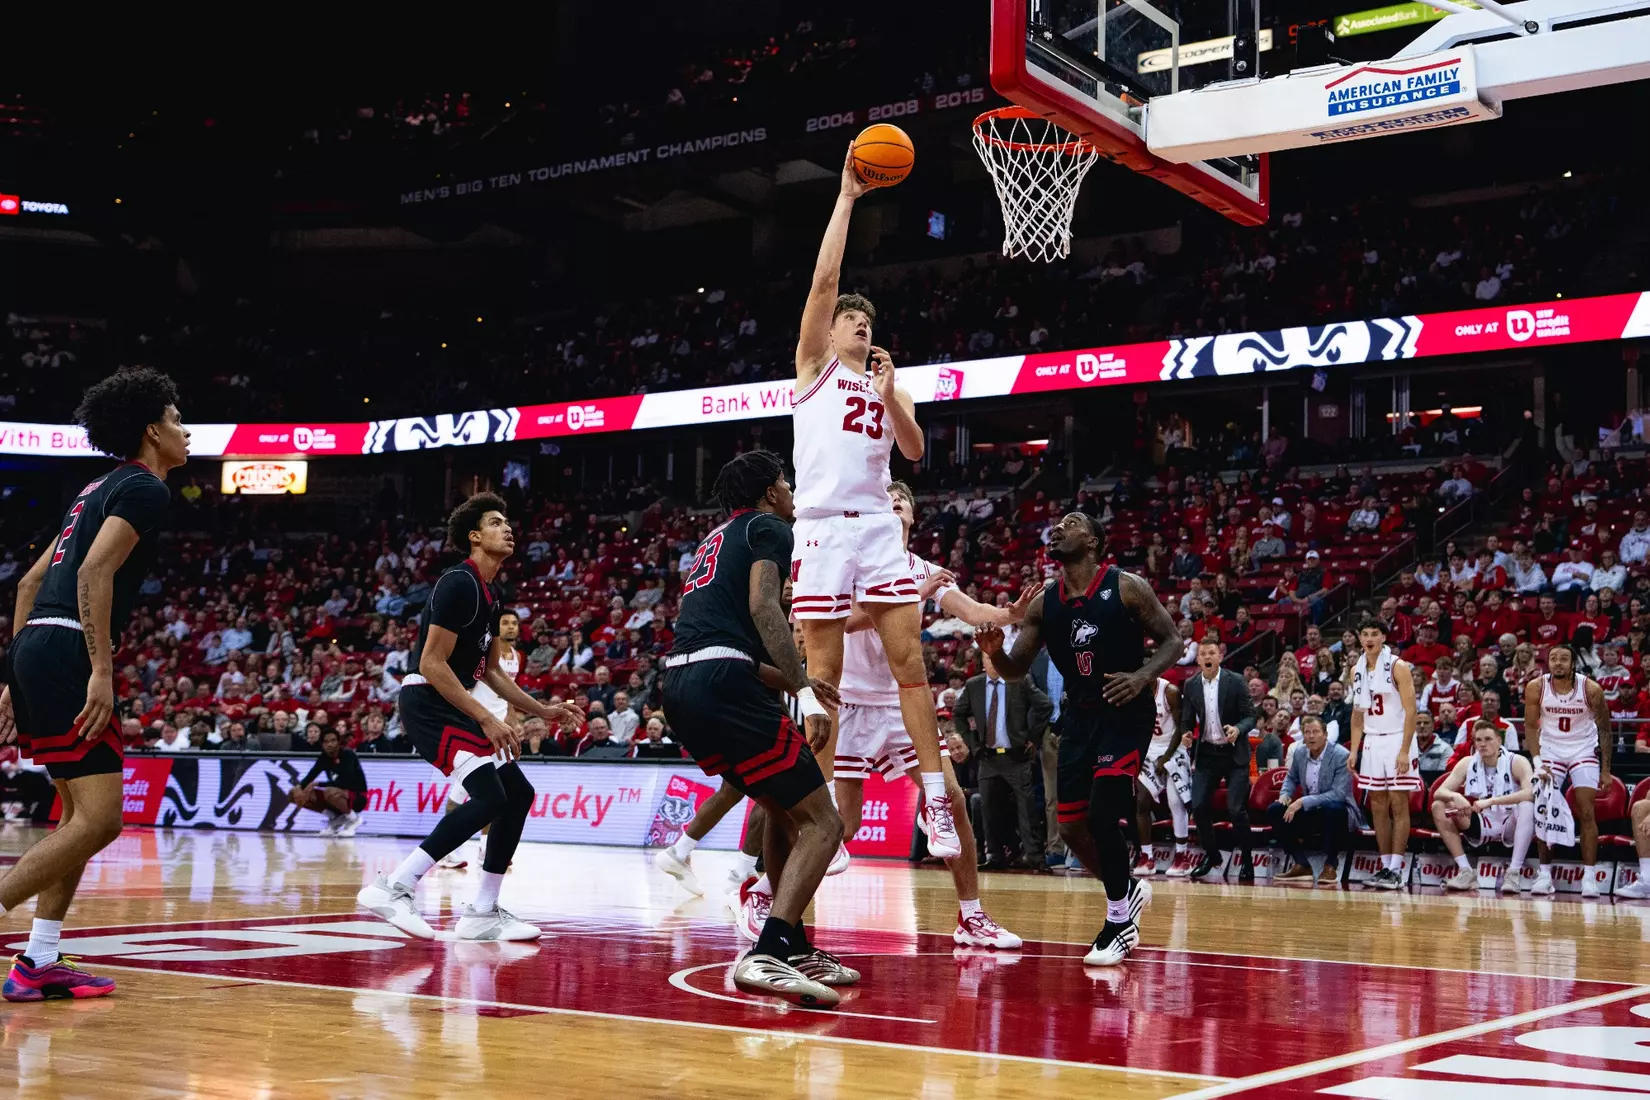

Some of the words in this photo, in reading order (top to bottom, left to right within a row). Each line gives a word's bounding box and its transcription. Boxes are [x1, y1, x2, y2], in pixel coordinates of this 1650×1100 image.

[1328, 80, 1401, 103] AMERICAN
[1407, 67, 1460, 89] FAMILY
[1337, 85, 1451, 113] INSURANCE
[806, 112, 854, 132] 2004
[868, 99, 919, 121] 2008
[935, 87, 985, 109] 2015
[400, 186, 450, 205] MEN'S
[456, 180, 483, 196] BIG
[489, 173, 521, 189] TEN
[528, 148, 651, 182] TOURNAMENT
[656, 127, 768, 159] CHAMPIONS
[863, 166, 903, 182] Wilson
[21, 200, 69, 215] TOYOTA
[1455, 324, 1483, 336] ONLY
[1485, 322, 1499, 333] AT
[702, 392, 750, 415] Bank
[760, 387, 795, 409] Wit
[842, 396, 885, 440] 23
[52, 500, 85, 567] 2
[682, 531, 725, 597] 23
[1545, 706, 1584, 715] WISCONSIN
[1559, 716, 1571, 733] 0
